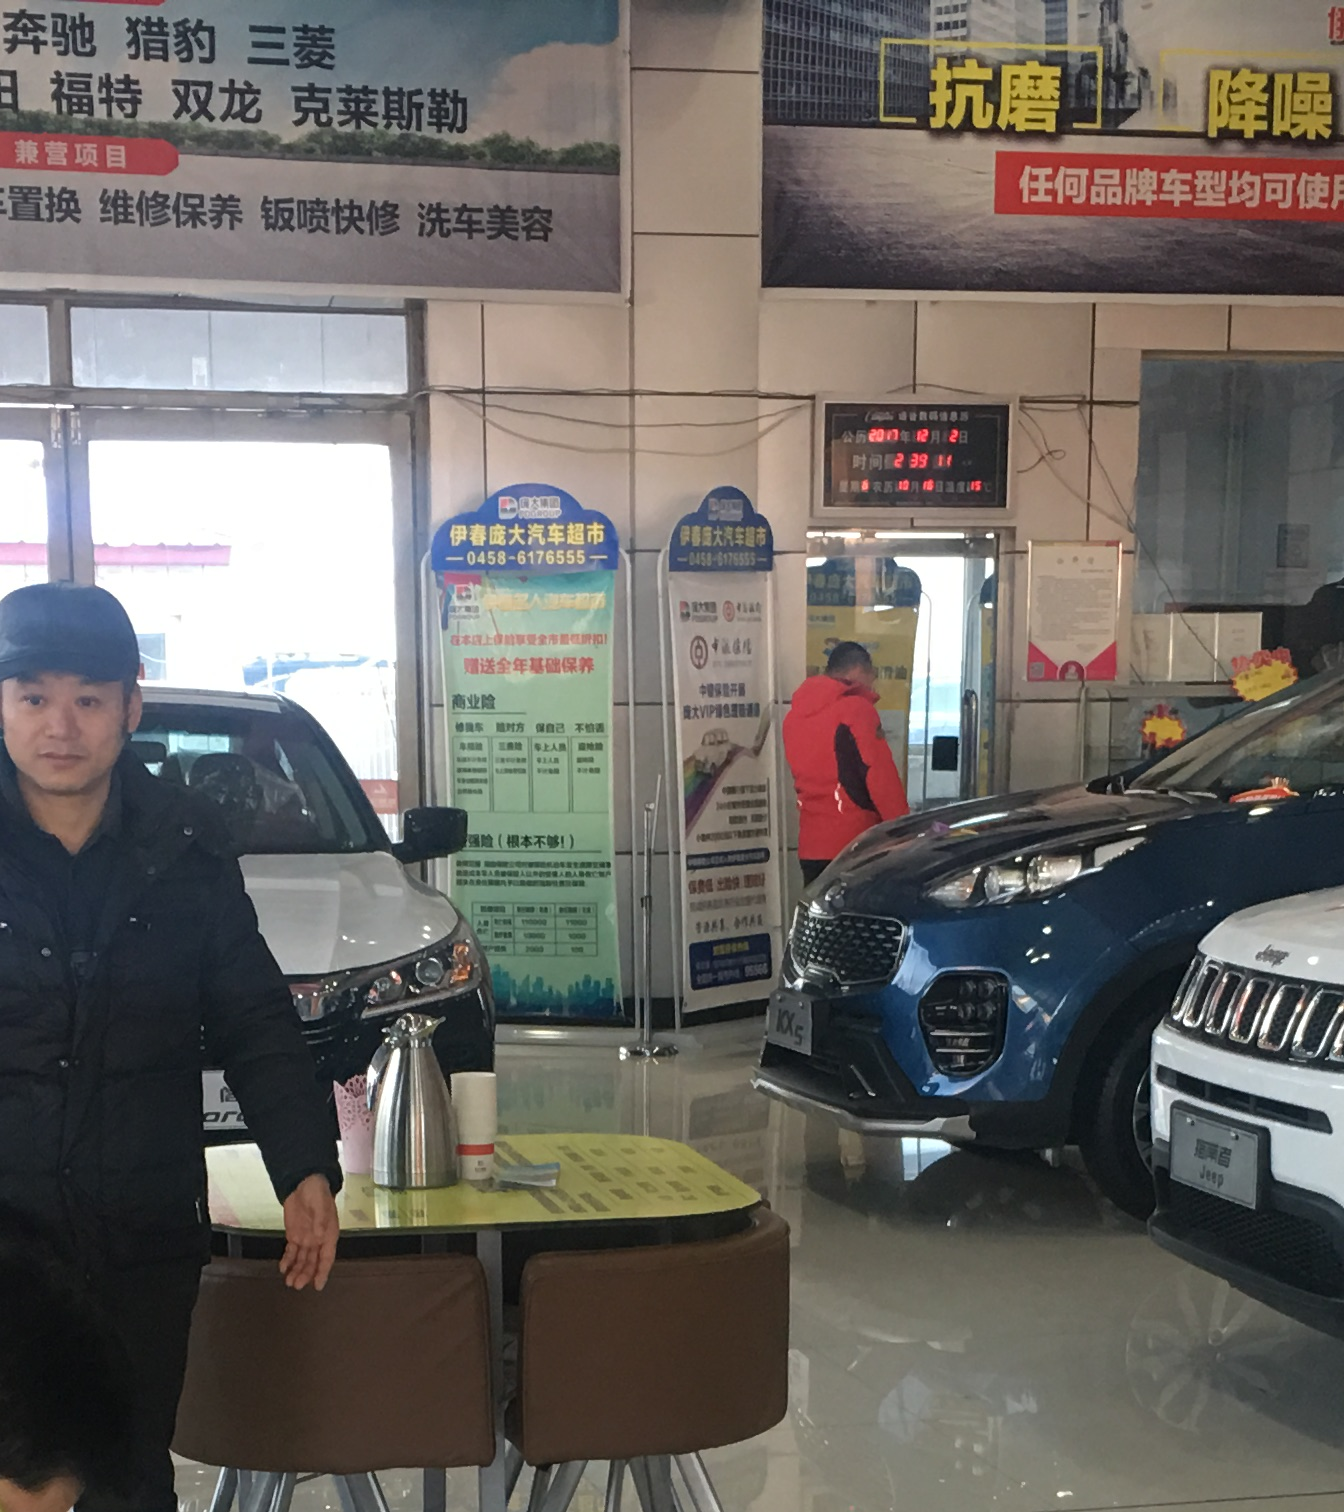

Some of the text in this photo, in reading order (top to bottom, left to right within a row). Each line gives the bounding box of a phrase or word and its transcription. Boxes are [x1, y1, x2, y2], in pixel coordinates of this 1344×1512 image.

[3, 8, 96, 58] 奔驰
[126, 16, 216, 63] 猎豹
[248, 24, 336, 70] 三菱
[50, 71, 142, 120] 福特
[171, 78, 262, 124] 双龙
[291, 82, 467, 134] 克莱斯勒
[929, 58, 1063, 134] 抗磨
[1207, 67, 1333, 140] 降噪
[15, 139, 127, 169] 兼营项目
[100, 188, 243, 230] 维修保养
[261, 195, 400, 237] 钣喷快修
[418, 201, 553, 242] 洗车美容
[450, 523, 605, 546] 伊春庞大汽车超市
[680, 525, 766, 547] 伊春庞大汽车超市
[467, 551, 585, 565] 0458-6176555
[464, 657, 594, 675] 赠送全年基础保养
[452, 694, 496, 710] 商业险
